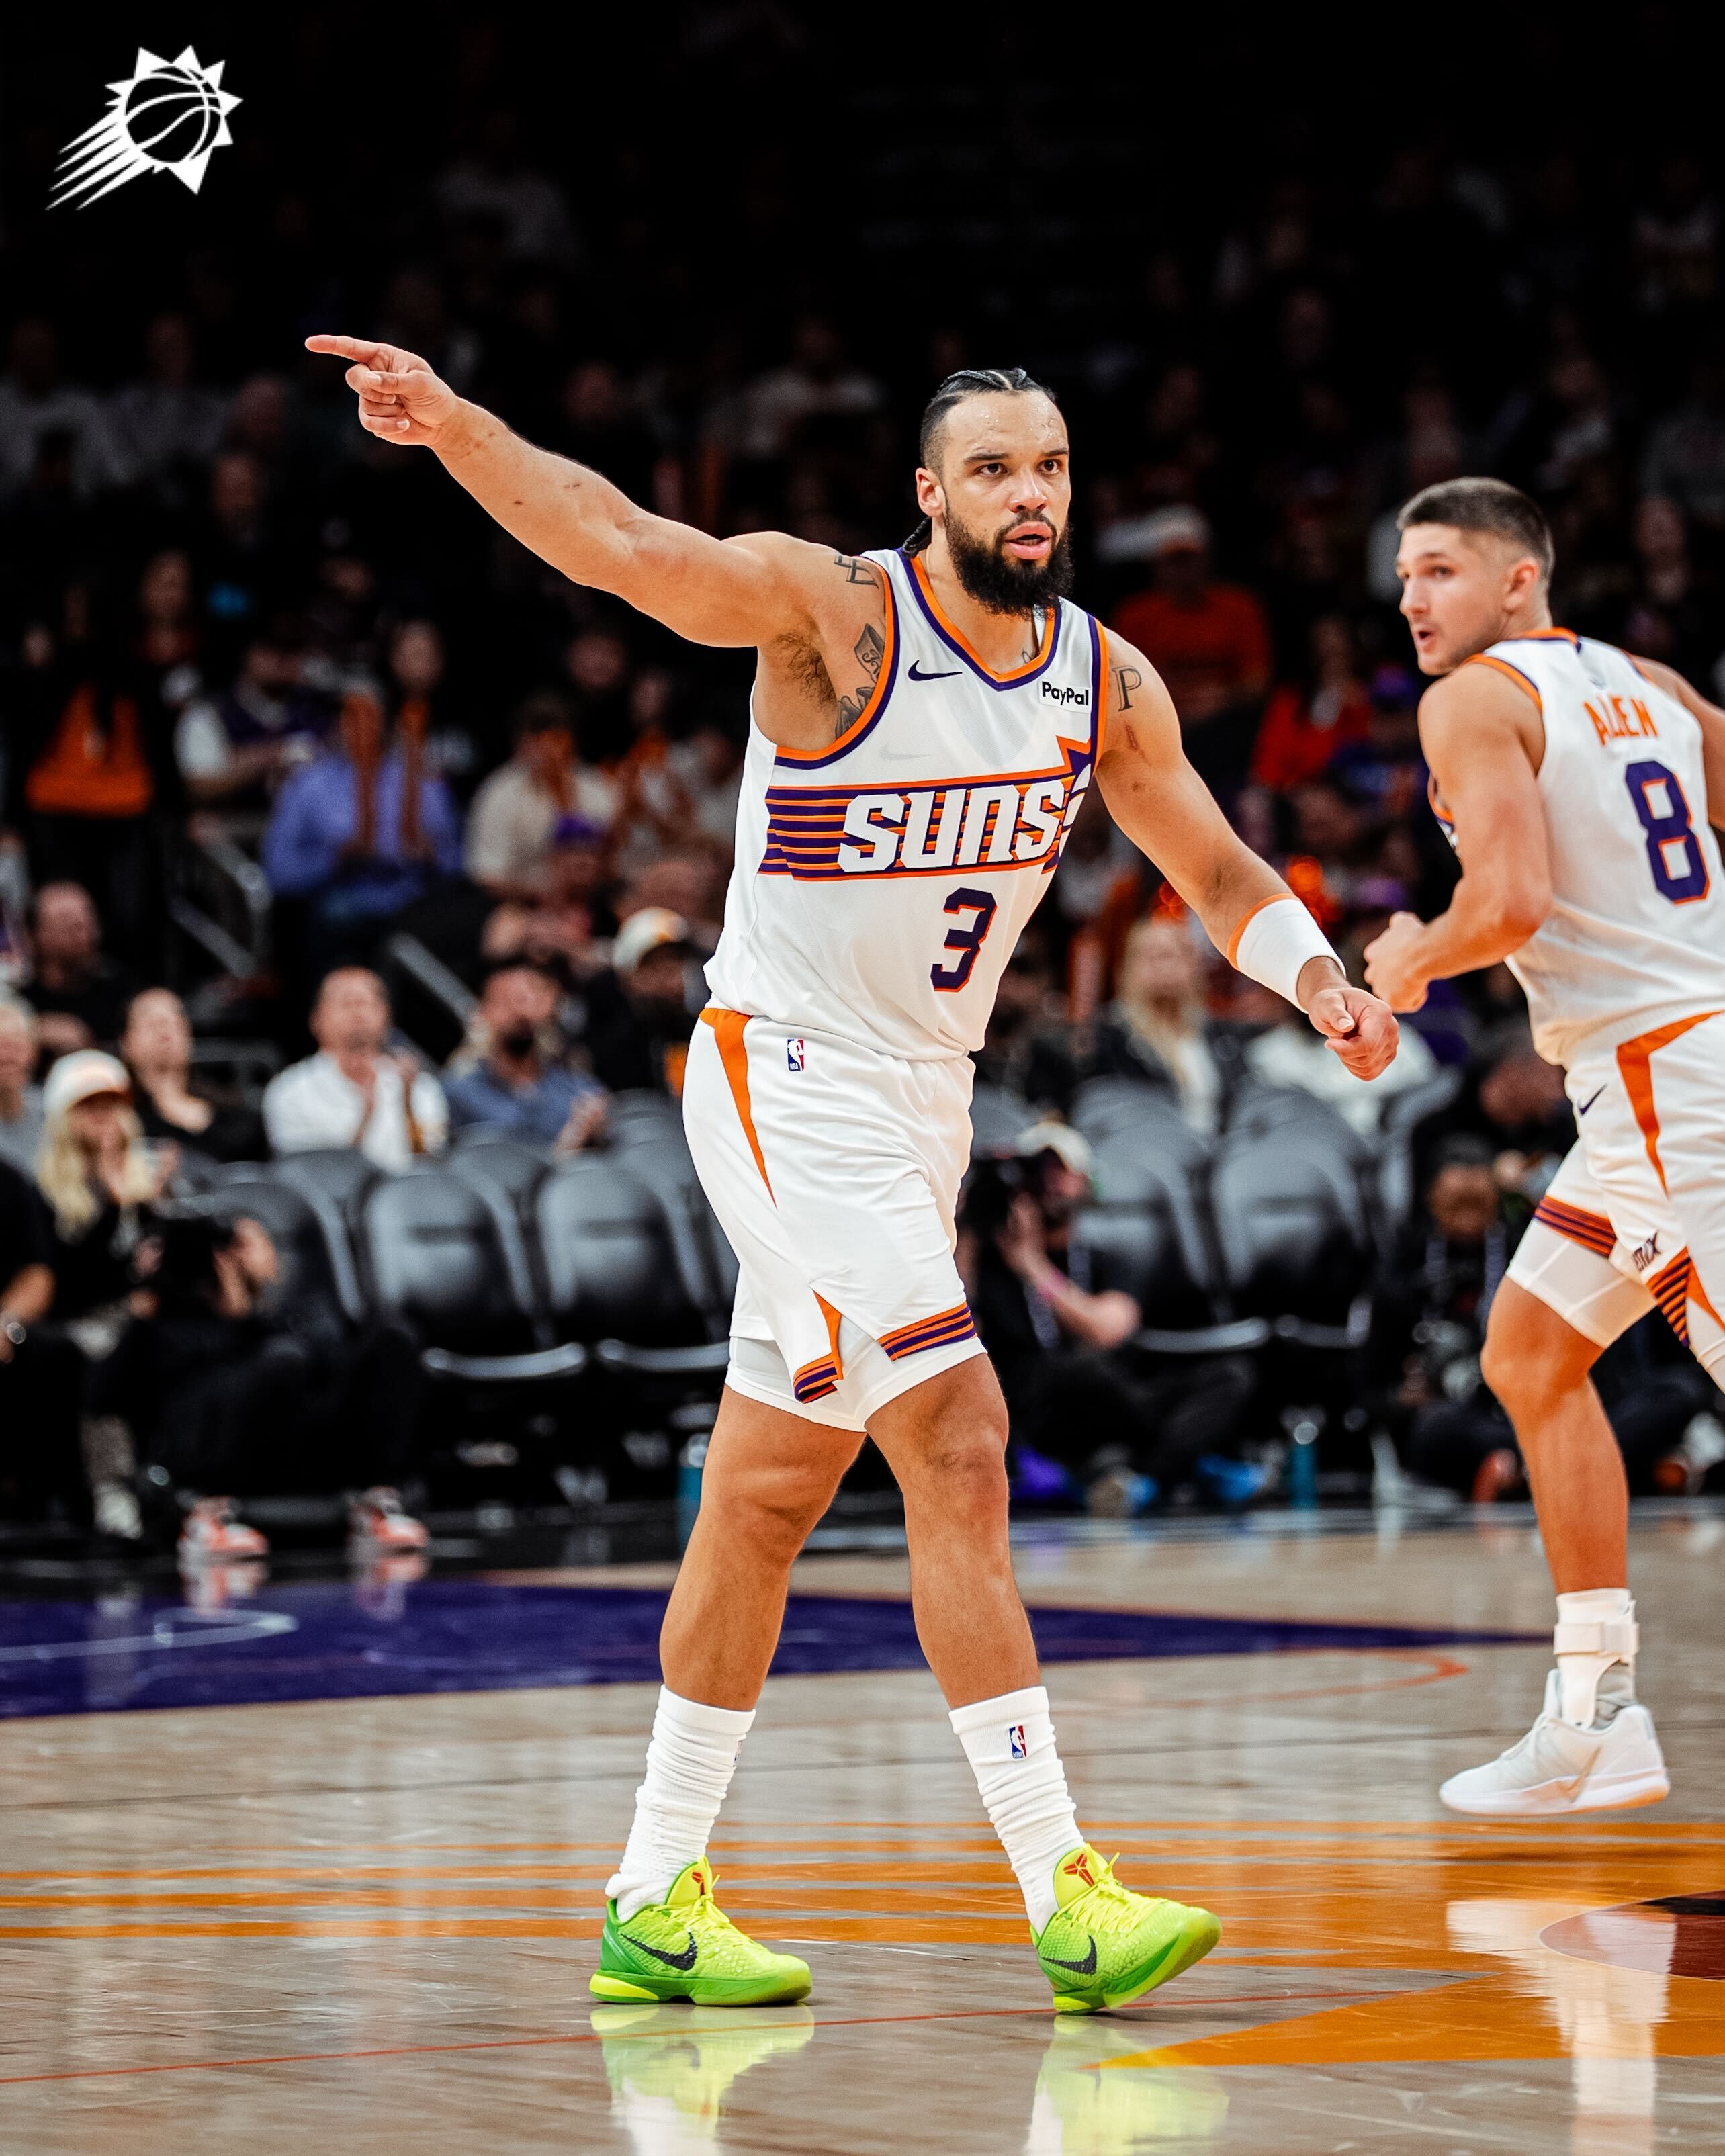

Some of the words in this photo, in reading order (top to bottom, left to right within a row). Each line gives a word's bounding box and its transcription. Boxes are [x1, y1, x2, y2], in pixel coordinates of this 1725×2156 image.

[1042, 681, 1089, 706] PayPal
[837, 779, 1065, 872] SUNS
[1624, 760, 1710, 905] 8
[930, 887, 998, 993] 3
